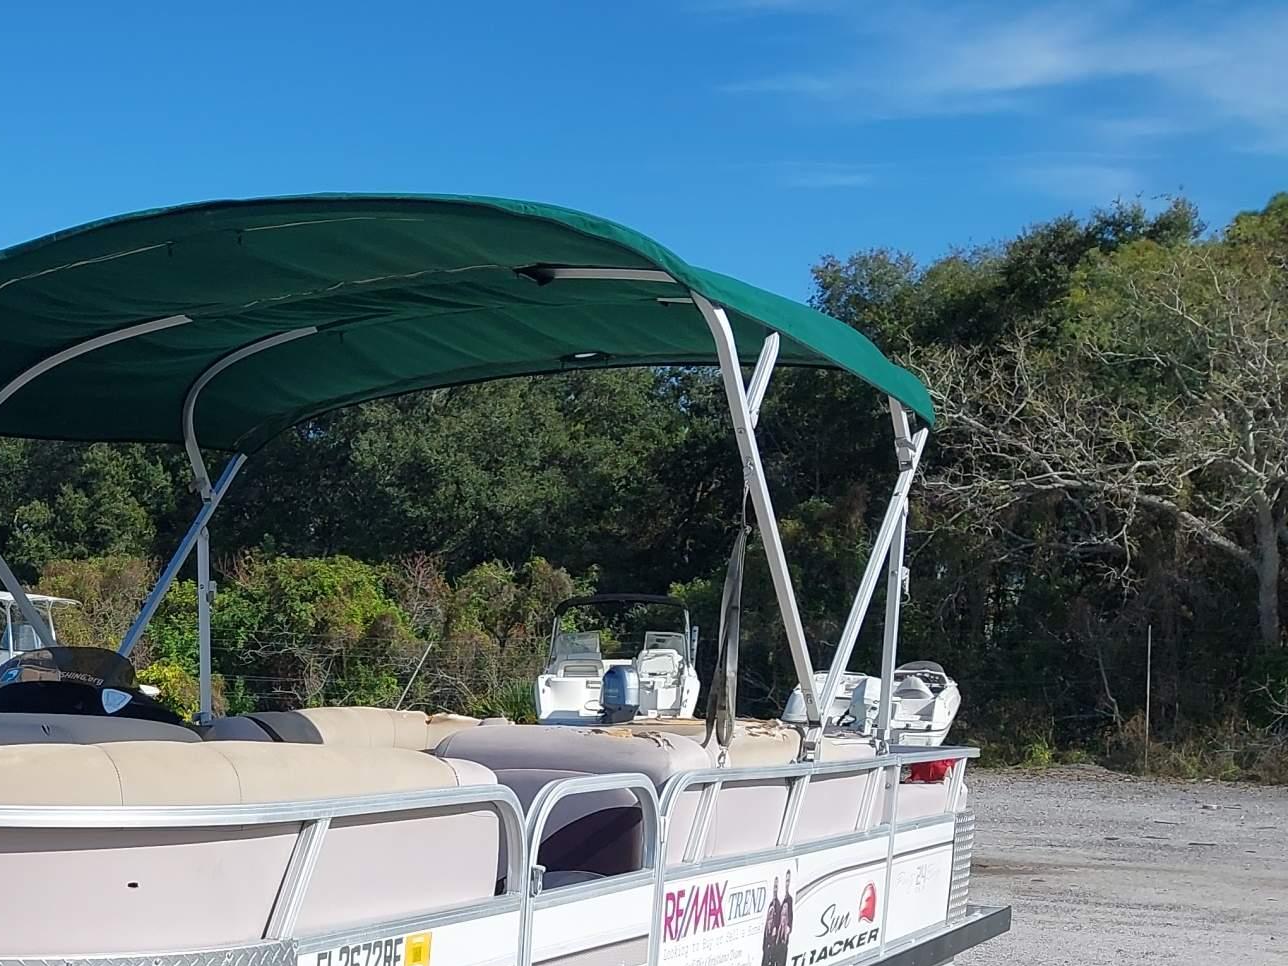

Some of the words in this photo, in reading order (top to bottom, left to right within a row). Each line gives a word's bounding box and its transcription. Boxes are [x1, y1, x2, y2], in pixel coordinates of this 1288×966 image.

[663, 880, 728, 943] RE/MAX
[728, 887, 767, 921] TREND
[815, 904, 852, 938] Sun
